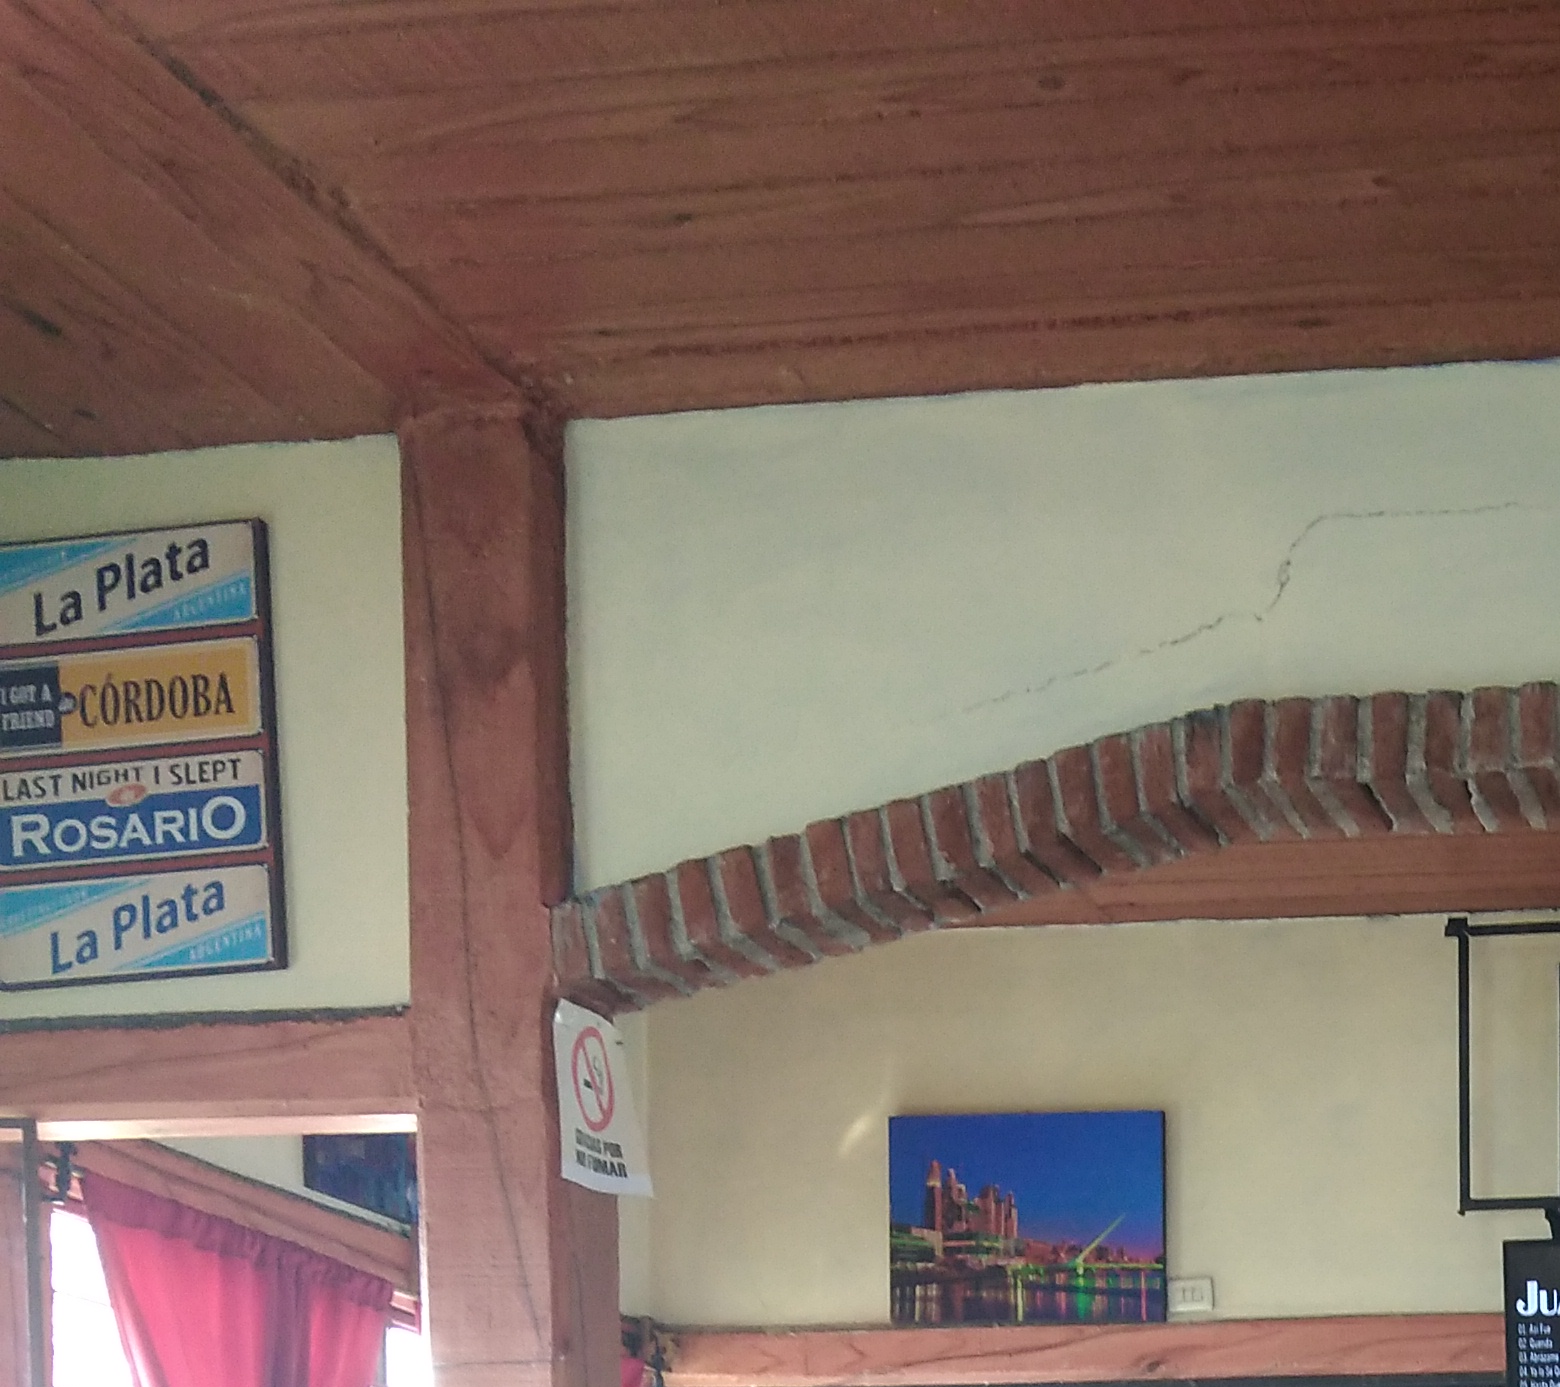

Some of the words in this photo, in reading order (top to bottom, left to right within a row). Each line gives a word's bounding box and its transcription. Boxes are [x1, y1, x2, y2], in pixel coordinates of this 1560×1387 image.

[34, 590, 83, 636] La
[96, 538, 210, 612] Plata
[1, 709, 55, 731] FRIEND
[41, 684, 52, 702] A
[79, 671, 235, 729] CÓRDOBA
[3, 774, 62, 801] LAST
[72, 766, 145, 794] NIGHT
[153, 765, 160, 785] I
[171, 758, 242, 785] SLEPT
[11, 796, 246, 857] ROSARIO
[50, 930, 98, 975] La
[112, 881, 225, 950] Plata
